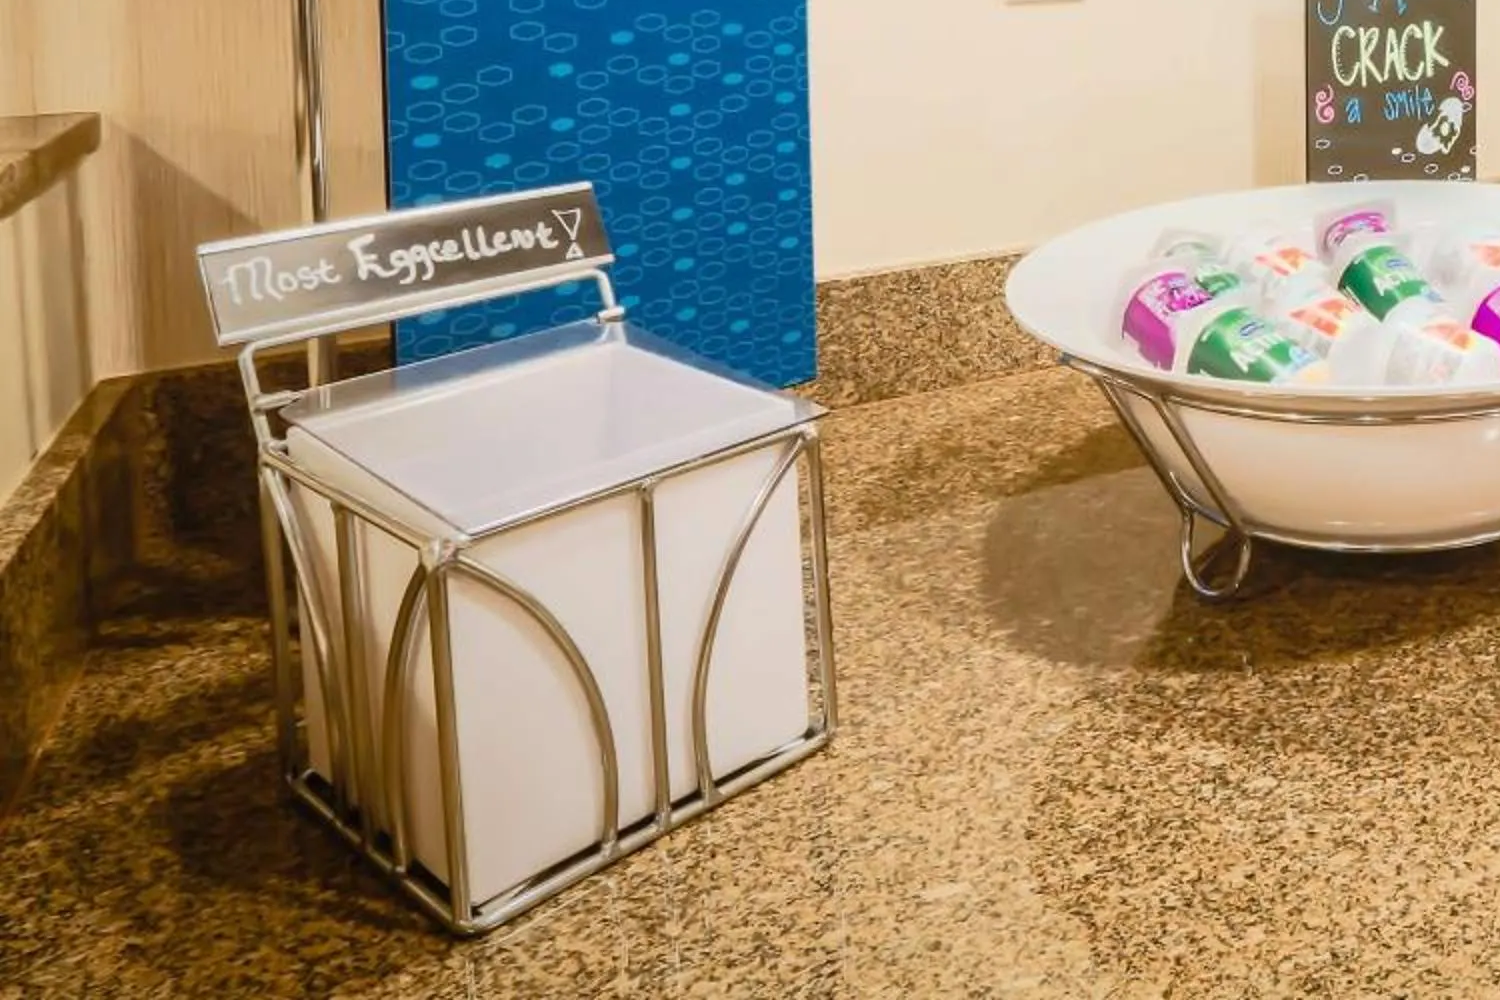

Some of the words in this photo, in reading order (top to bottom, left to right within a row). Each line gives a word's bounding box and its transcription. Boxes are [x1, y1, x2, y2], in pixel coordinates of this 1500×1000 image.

[1331, 20, 1449, 87] CRACK
[1345, 97, 1361, 124] a
[1384, 85, 1436, 121] smile
[222, 254, 342, 306] Most
